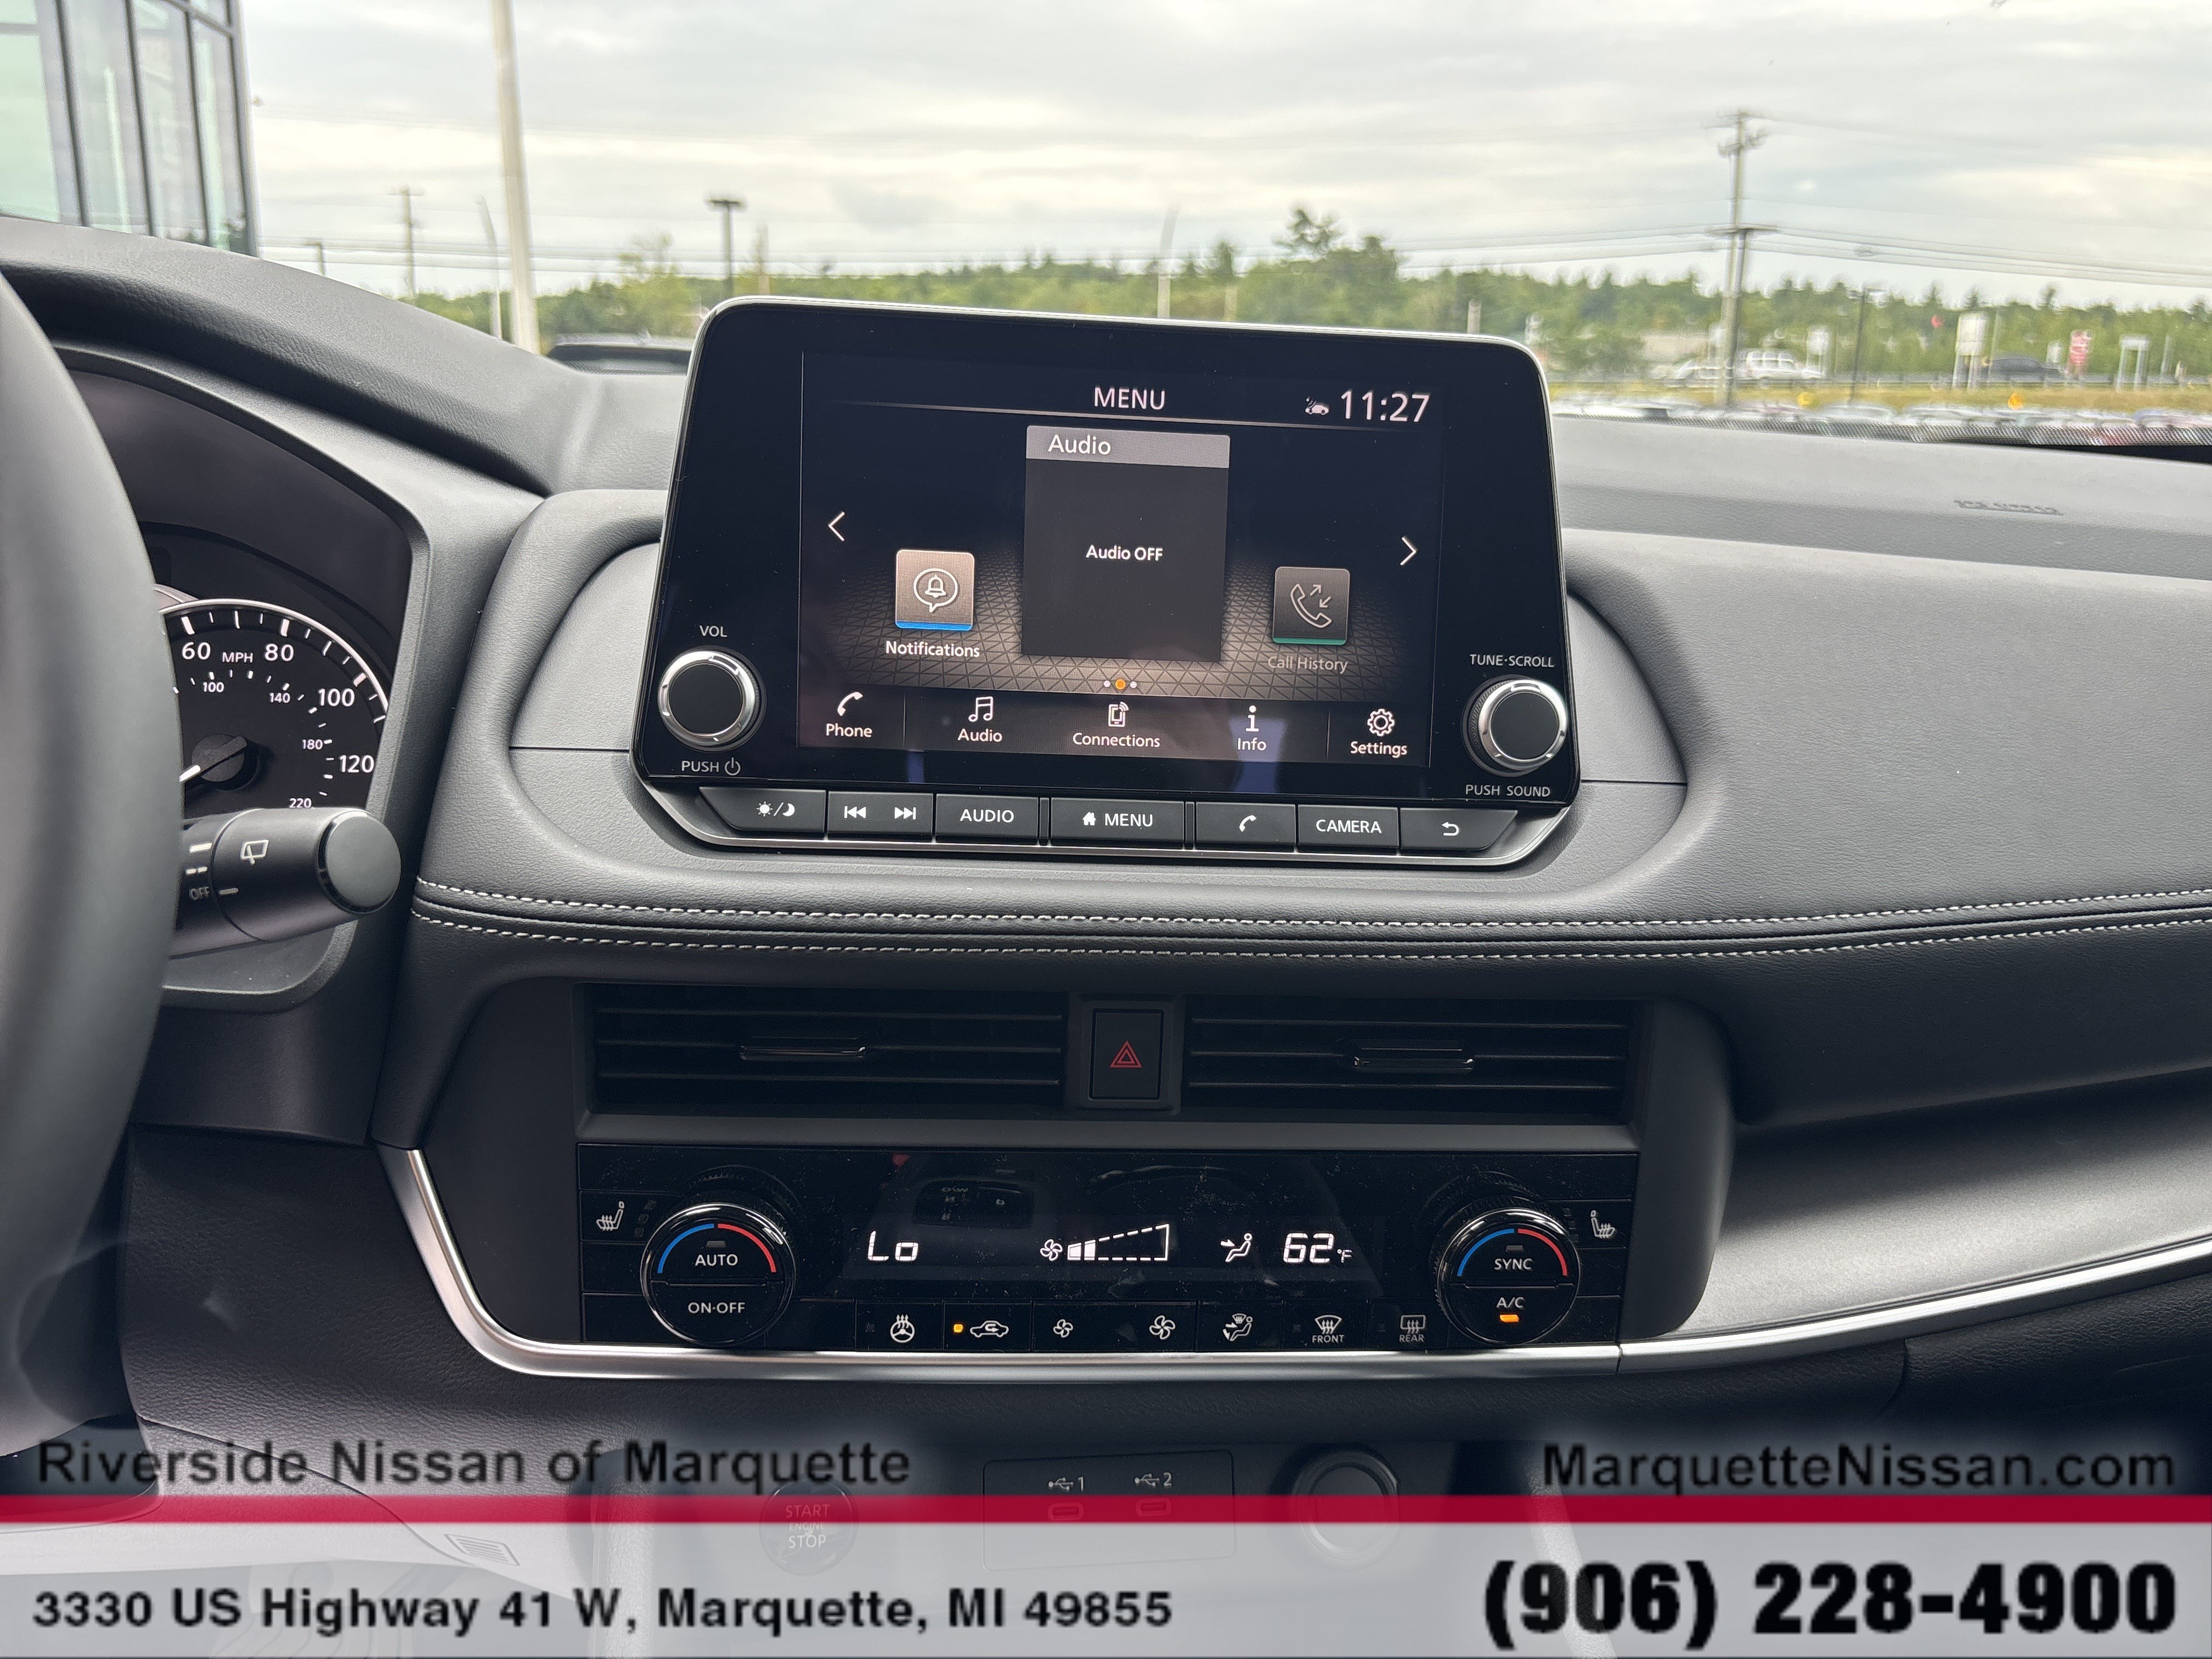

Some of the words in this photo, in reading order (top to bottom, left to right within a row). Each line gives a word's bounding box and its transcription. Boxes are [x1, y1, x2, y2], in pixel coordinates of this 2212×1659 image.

[1093, 386, 1166, 411] MENU
[1340, 390, 1431, 423] 11:27
[1047, 433, 1112, 456] Audio
[1085, 544, 1131, 560] Audio
[1133, 546, 1164, 562] OFF
[699, 624, 729, 638] VOL
[182, 641, 211, 661] 60
[264, 643, 295, 662] 80
[885, 639, 981, 658] Notifications
[222, 651, 254, 664] MPH
[1268, 655, 1293, 670] Call
[1297, 657, 1348, 675] History
[202, 681, 225, 693] 100
[269, 691, 291, 704] 140
[318, 688, 355, 707] 100
[826, 721, 873, 738] Phone
[957, 728, 1003, 743] Audio
[302, 738, 324, 751] 180
[1072, 731, 1161, 748] Connections
[1237, 736, 1267, 752] Info
[1350, 740, 1408, 759] Settings
[339, 754, 375, 774] 120
[681, 759, 720, 773] PUSH
[1465, 783, 1500, 797] PUSH
[1506, 785, 1551, 798] SOUND
[289, 797, 312, 809] 220
[959, 808, 1015, 823] AUDIO
[1104, 812, 1154, 828] MENU
[1315, 818, 1383, 835] CAMERA
[188, 885, 210, 901] OFF
[694, 1252, 738, 1267] AUTO
[1493, 1257, 1533, 1271] SYNC
[1496, 1295, 1525, 1310] A/C
[1311, 1333, 1345, 1344] FRONT
[1398, 1332, 1425, 1343] REAR
[785, 1504, 831, 1519] START
[788, 1534, 827, 1549] STOP
